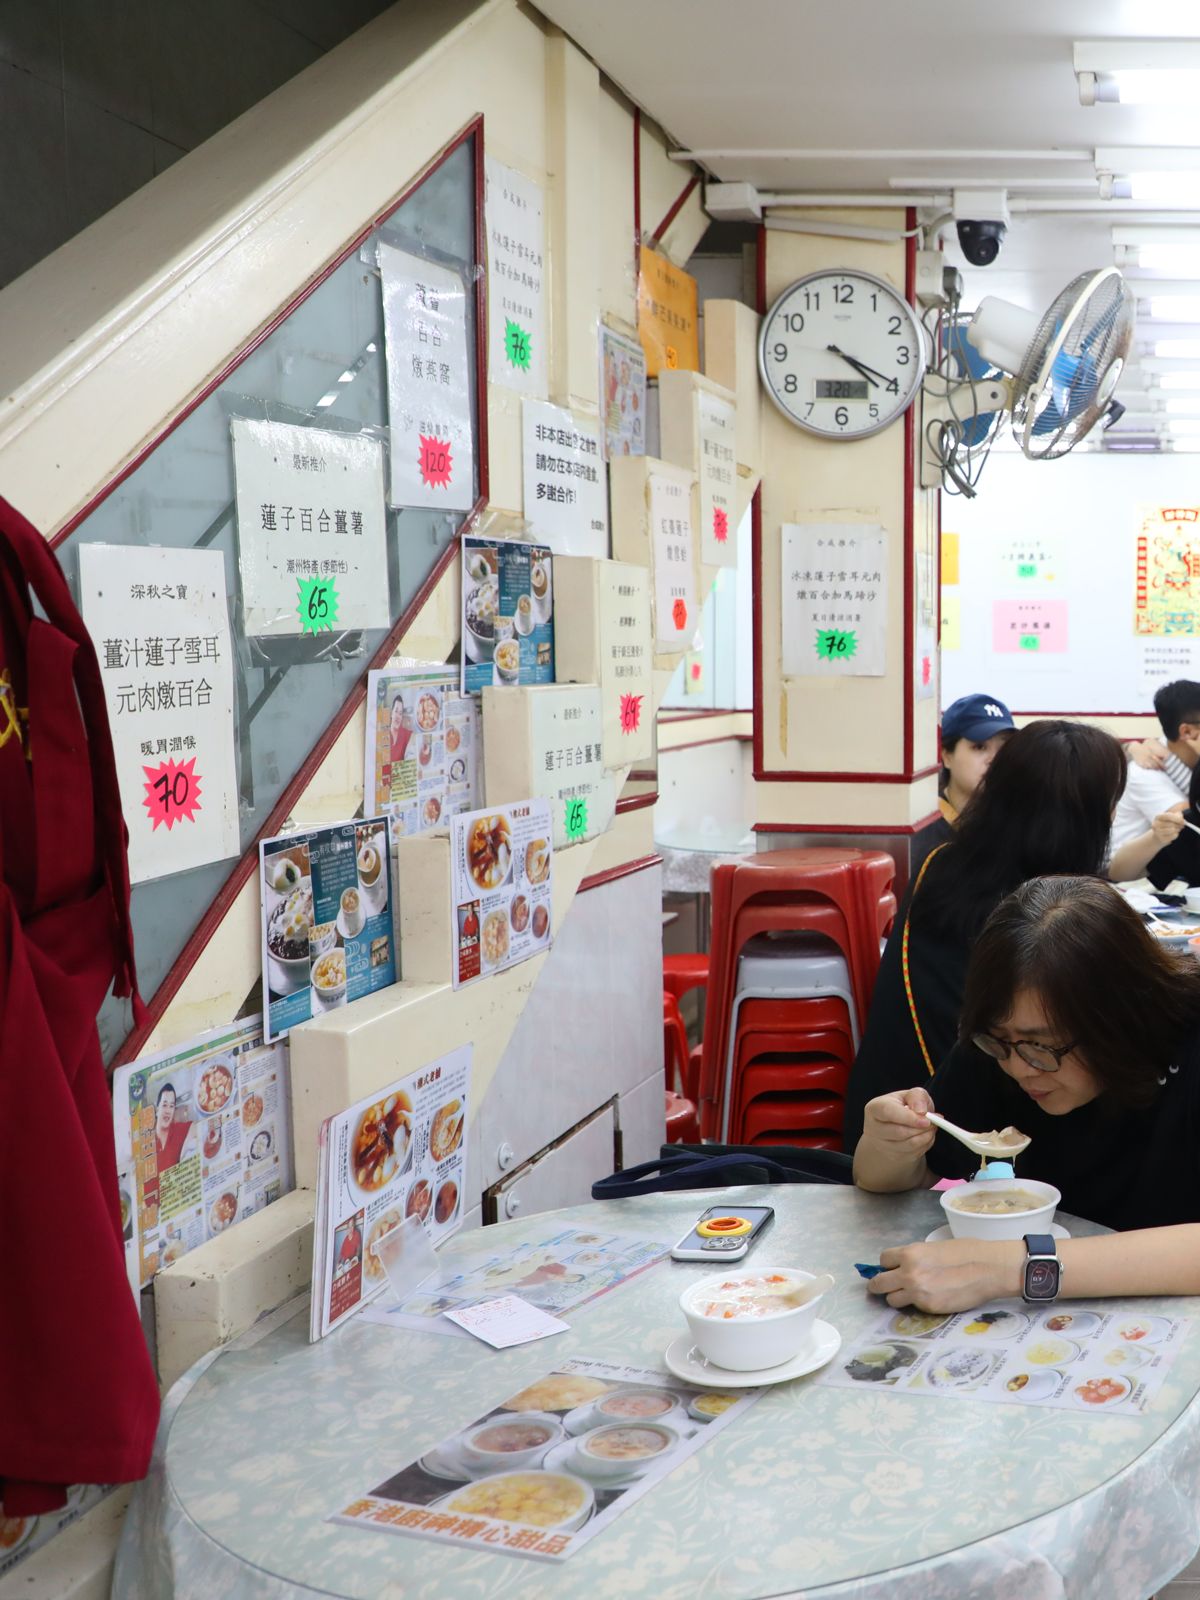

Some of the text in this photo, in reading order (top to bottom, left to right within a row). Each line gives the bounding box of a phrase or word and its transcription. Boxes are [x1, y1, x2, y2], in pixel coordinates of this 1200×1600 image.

[804, 292, 820, 311] 11
[833, 284, 854, 304] 12
[870, 294, 877, 312] 1
[783, 313, 805, 333] 10
[888, 316, 902, 335] 2
[511, 332, 527, 361] 76
[774, 343, 788, 362] 9
[896, 346, 910, 365] 3
[784, 374, 798, 393] 8
[886, 377, 900, 396] 4
[805, 402, 815, 417] 7
[835, 406, 849, 425] 6
[869, 403, 879, 417] 5
[424, 449, 447, 474] 120
[260, 503, 364, 536] 蓮子百合薑薯
[130, 583, 189, 600] 深秋之寶
[308, 585, 329, 620] 65
[102, 635, 221, 670] 薑汁蓮子雪耳
[825, 635, 848, 655] 76
[116, 677, 214, 716] 元肉燉百合
[140, 734, 197, 756] 暖胃潤喉
[153, 771, 190, 813] 70
[570, 802, 583, 833] 65
[341, 1498, 573, 1556] 香港廚神精心甜品
